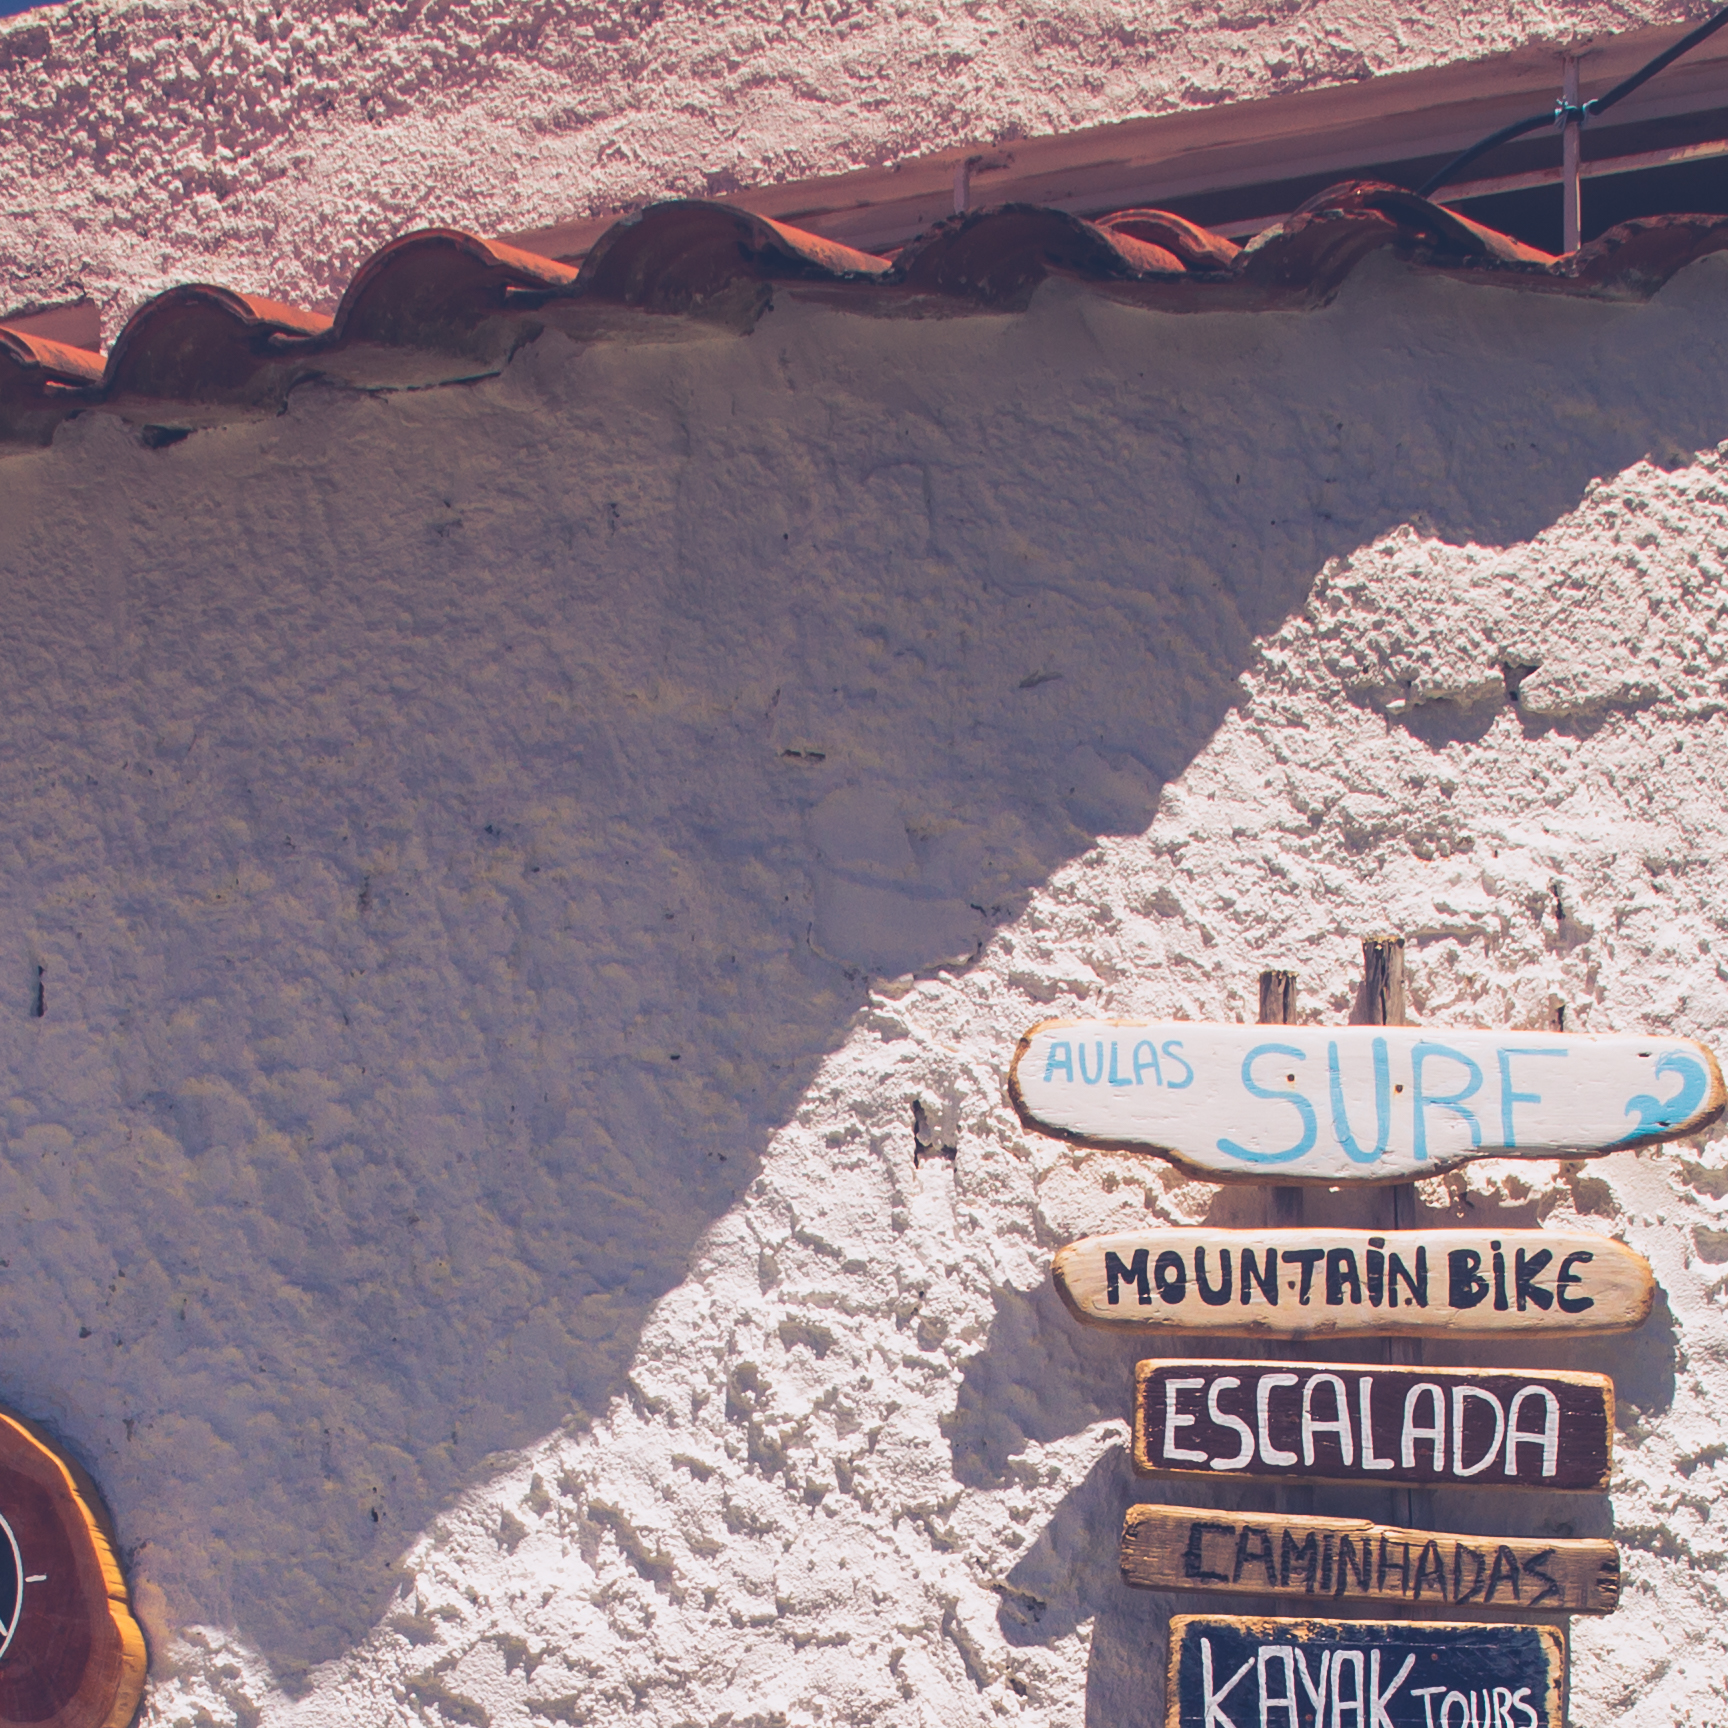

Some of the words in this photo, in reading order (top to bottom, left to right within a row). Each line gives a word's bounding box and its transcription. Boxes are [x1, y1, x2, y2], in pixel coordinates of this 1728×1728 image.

[1044, 1038, 1195, 1088] AULAS
[1216, 1036, 1569, 1163] SURF
[1163, 1376, 1559, 1476] ESCALADA
[1182, 1521, 1559, 1606] CAMINHADAS
